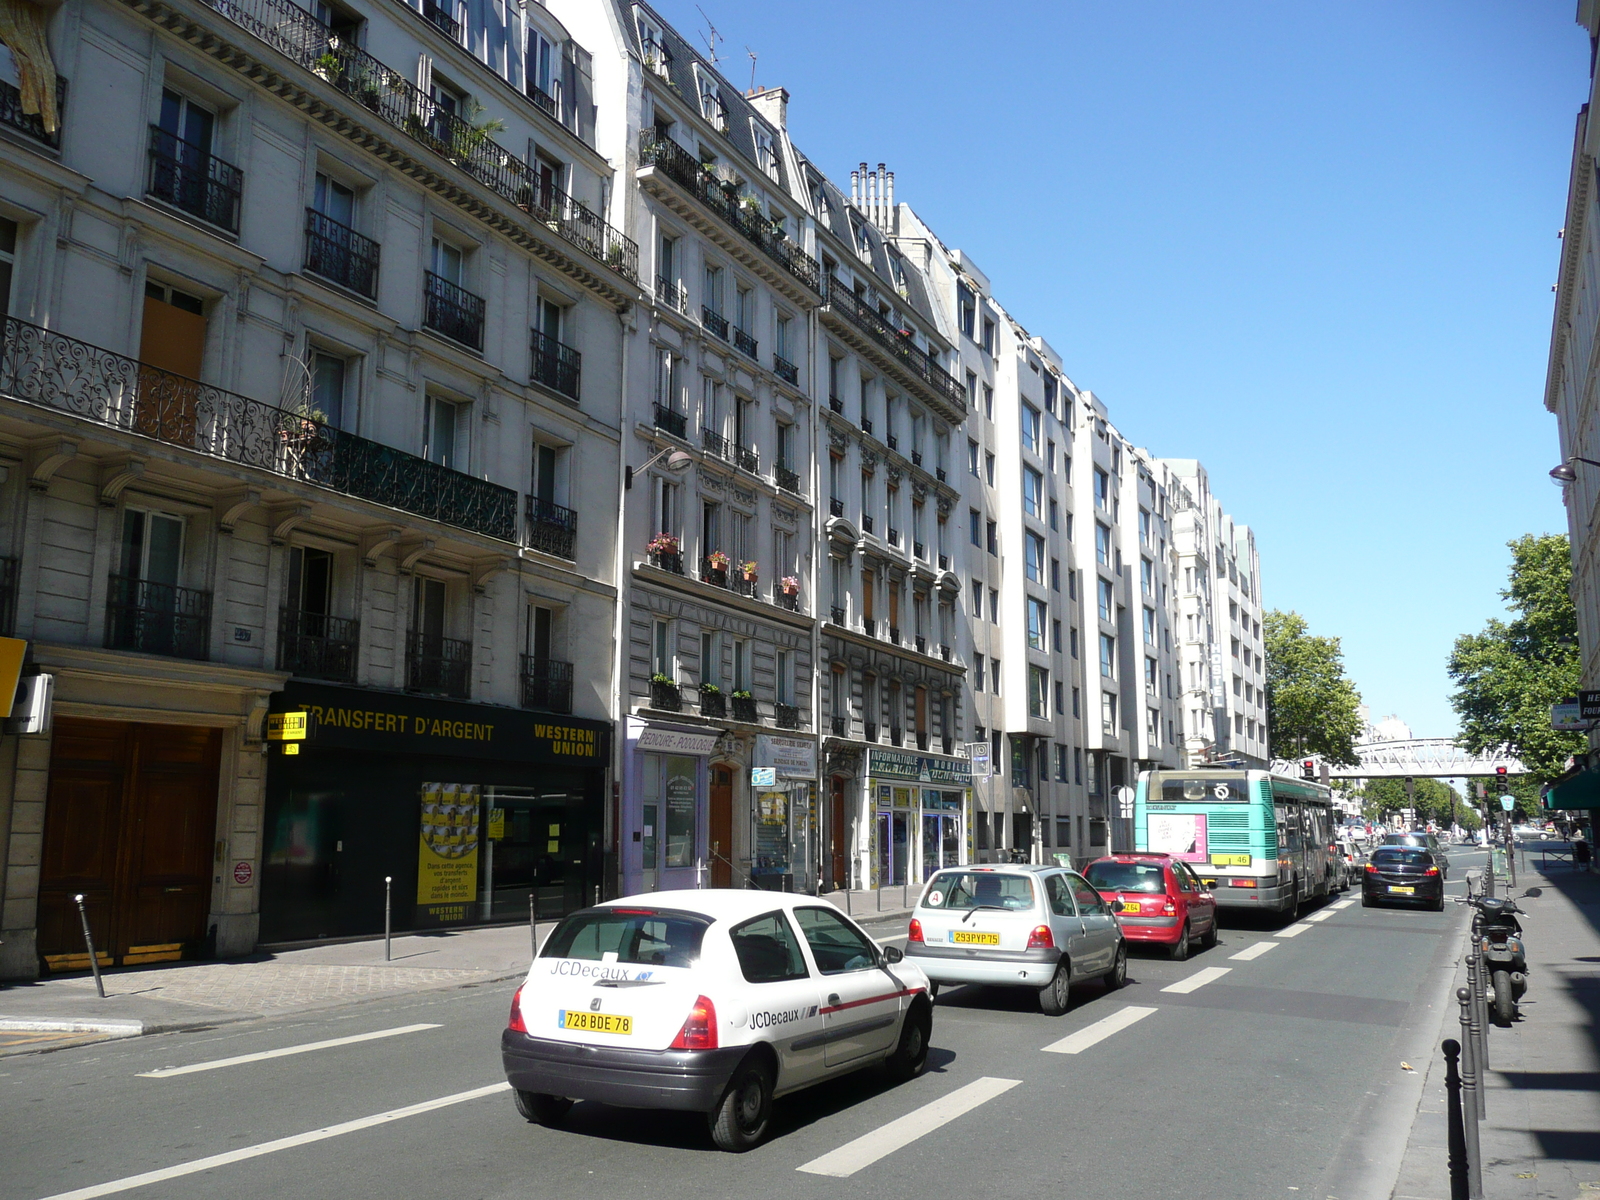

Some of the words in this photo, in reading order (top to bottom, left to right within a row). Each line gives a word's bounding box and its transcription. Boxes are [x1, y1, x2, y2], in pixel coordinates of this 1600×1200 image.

[1211, 643, 1223, 708] HOSTEL
[270, 717, 299, 725] WESTERN
[299, 704, 408, 733] TRANSFERT
[415, 717, 494, 742] D'ARGENT
[534, 724, 594, 742] WESTERN
[552, 740, 593, 757] UNION
[871, 750, 918, 765] INFORMATIQUE
[934, 760, 970, 773] MOBILES
[1237, 856, 1247, 864] 46
[429, 906, 463, 915] WESTERN
[440, 913, 463, 921] UNION
[550, 960, 629, 981] JCDecaux
[567, 1012, 587, 1028] 728
[590, 1015, 612, 1030] BDE
[615, 1017, 630, 1032] 78
[750, 1009, 799, 1030] JCDecaux
